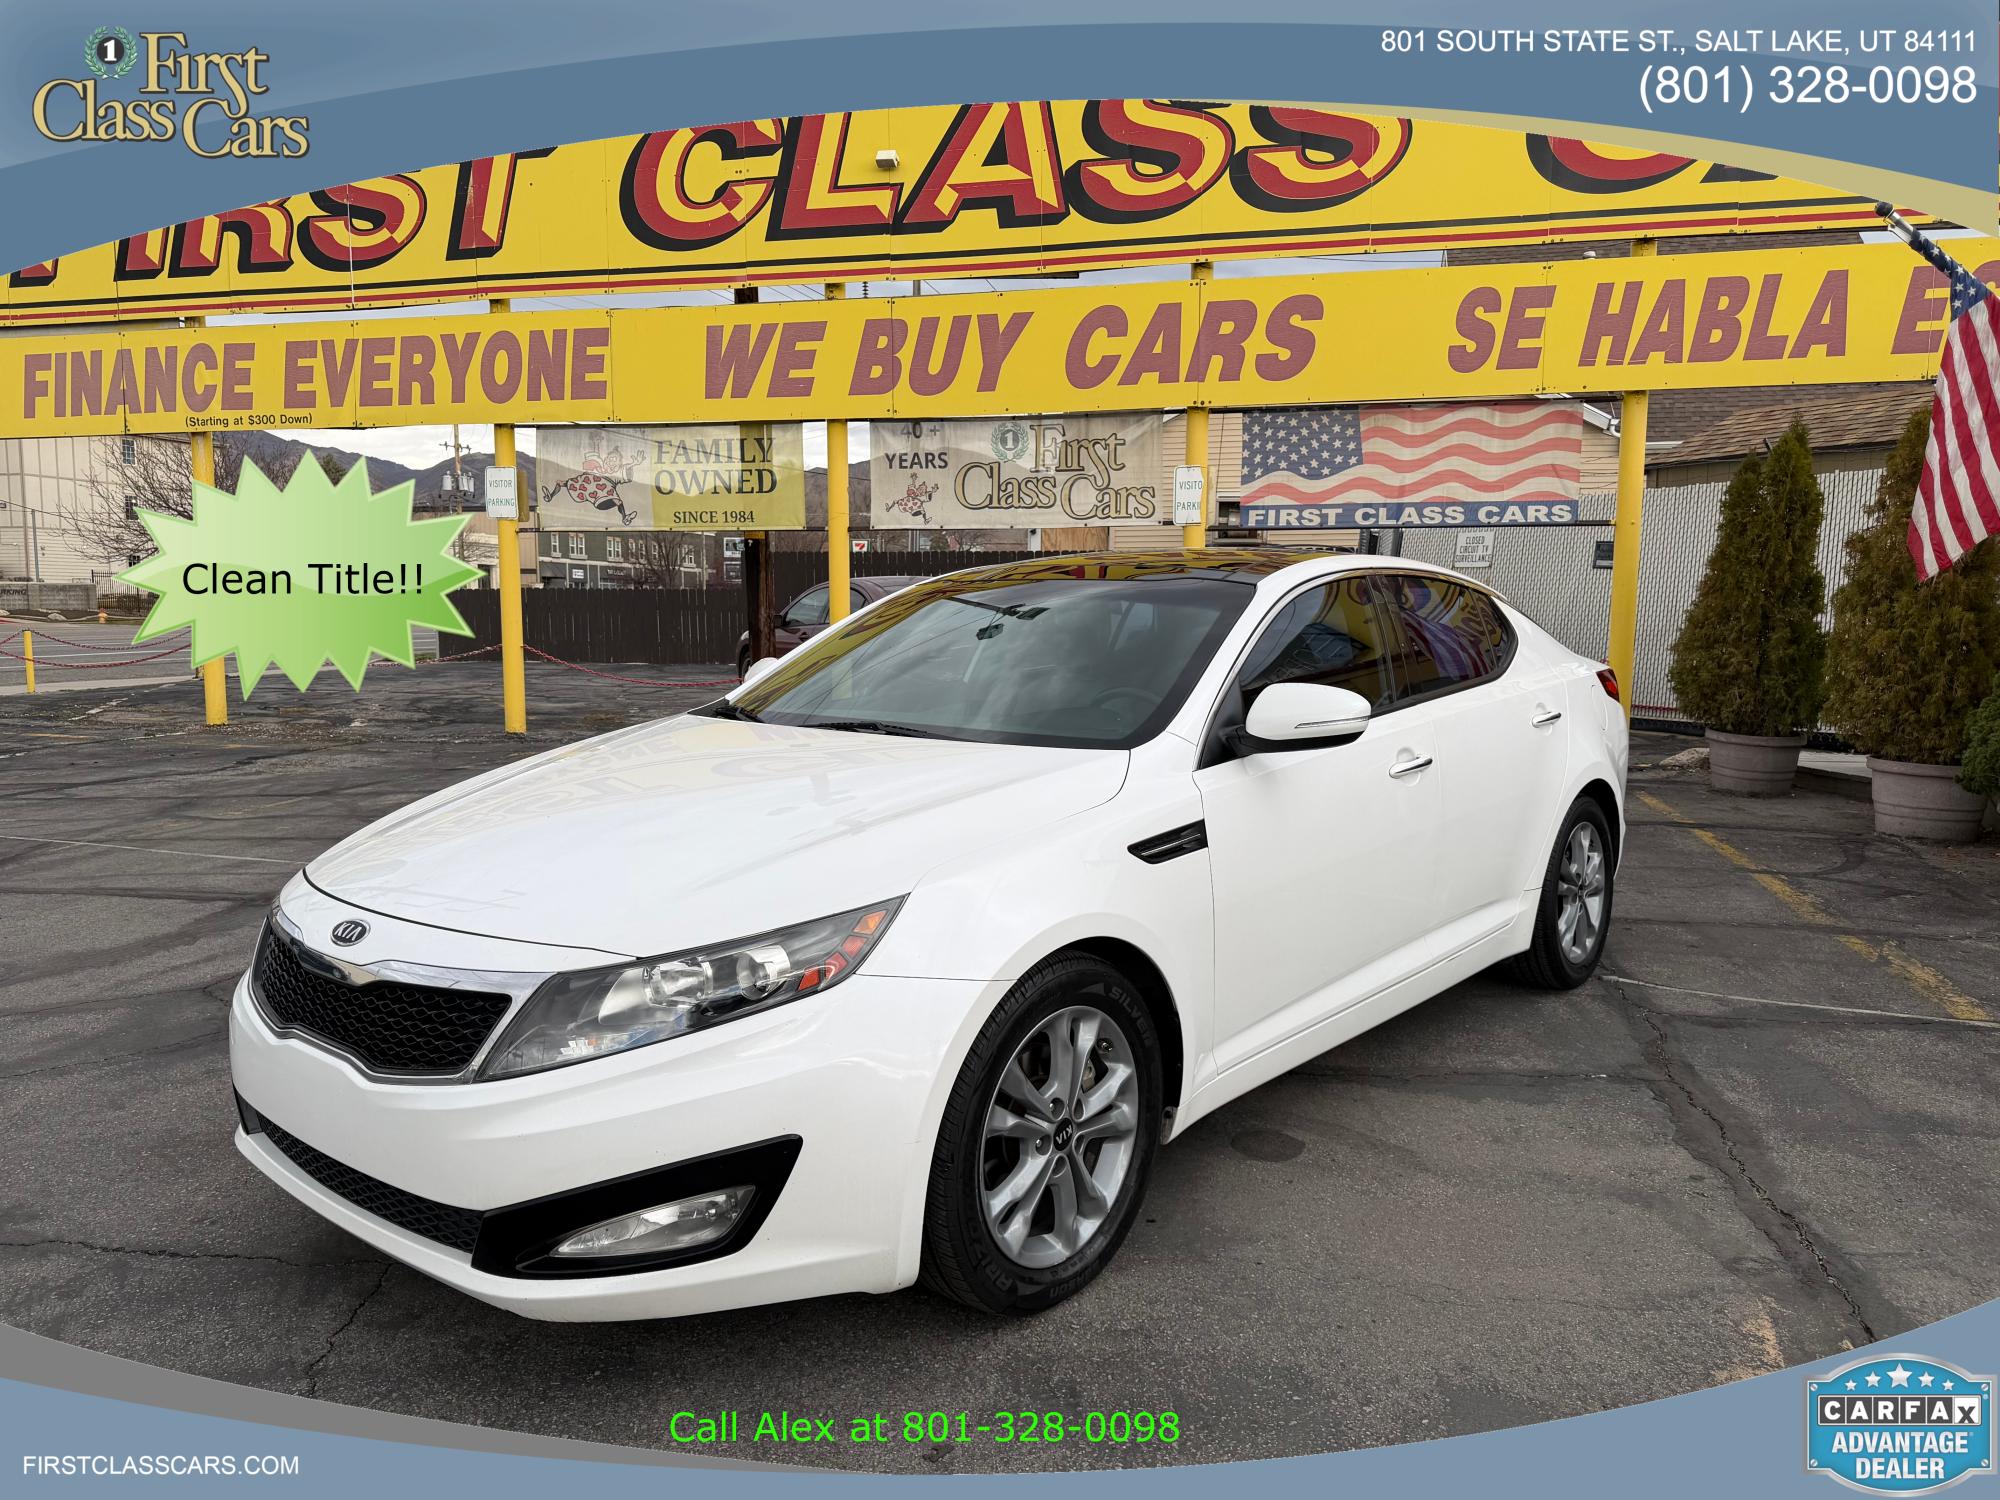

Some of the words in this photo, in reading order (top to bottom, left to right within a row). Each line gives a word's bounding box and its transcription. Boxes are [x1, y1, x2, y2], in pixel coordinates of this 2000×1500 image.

[9, 145, 558, 288] RST
[23, 342, 256, 420] FINANCE
[284, 327, 610, 410] EVERYONE
[705, 321, 827, 400] WE
[849, 312, 1034, 397] BUY
[1065, 294, 1324, 389] CARS
[1448, 285, 1556, 374] SE
[1578, 269, 1849, 367] HABLA
[185, 416, 229, 427] (Starting
[233, 416, 243, 426] at
[248, 414, 276, 425] $300
[280, 412, 312, 425] Down)
[900, 420, 923, 439] 40
[653, 438, 776, 465] FAMILY
[885, 452, 949, 470] YEARS
[1030, 424, 1126, 489] First
[488, 479, 513, 488] VISITOR
[654, 468, 778, 495] OWNED
[954, 460, 1057, 510] Class
[1060, 473, 1156, 520] Cars
[487, 497, 515, 507] PARKING
[673, 511, 718, 524] SINCE
[721, 510, 755, 523] 1984
[1248, 507, 1343, 527] FIRST
[1354, 505, 1465, 527] CLASS
[1477, 503, 1573, 525] CARS
[1465, 536, 1486, 545] CLOSED
[334, 922, 362, 941] KIA
[1054, 1124, 1073, 1144] KIA
